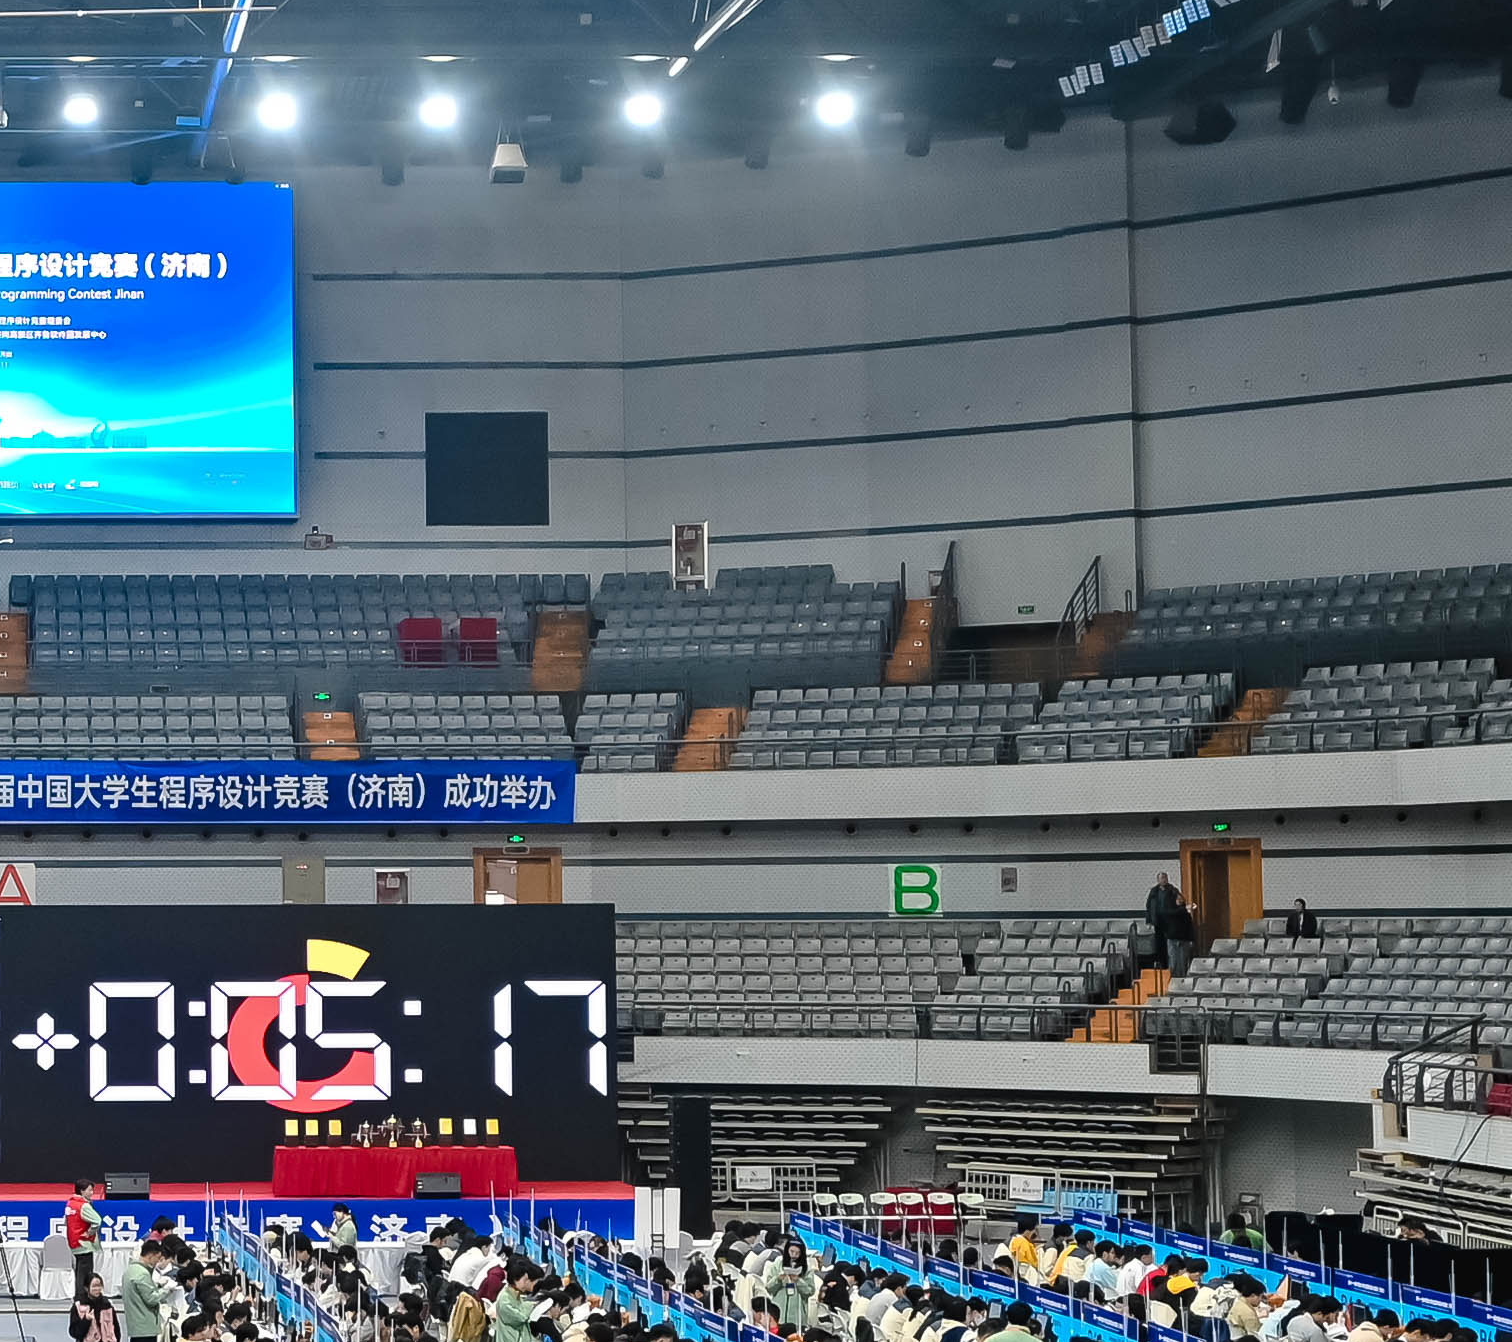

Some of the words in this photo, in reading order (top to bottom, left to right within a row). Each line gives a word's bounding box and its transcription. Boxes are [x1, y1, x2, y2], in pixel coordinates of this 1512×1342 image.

[68, 288, 111, 300] Contest
[114, 288, 144, 300] Jinan
[893, 865, 941, 915] B
